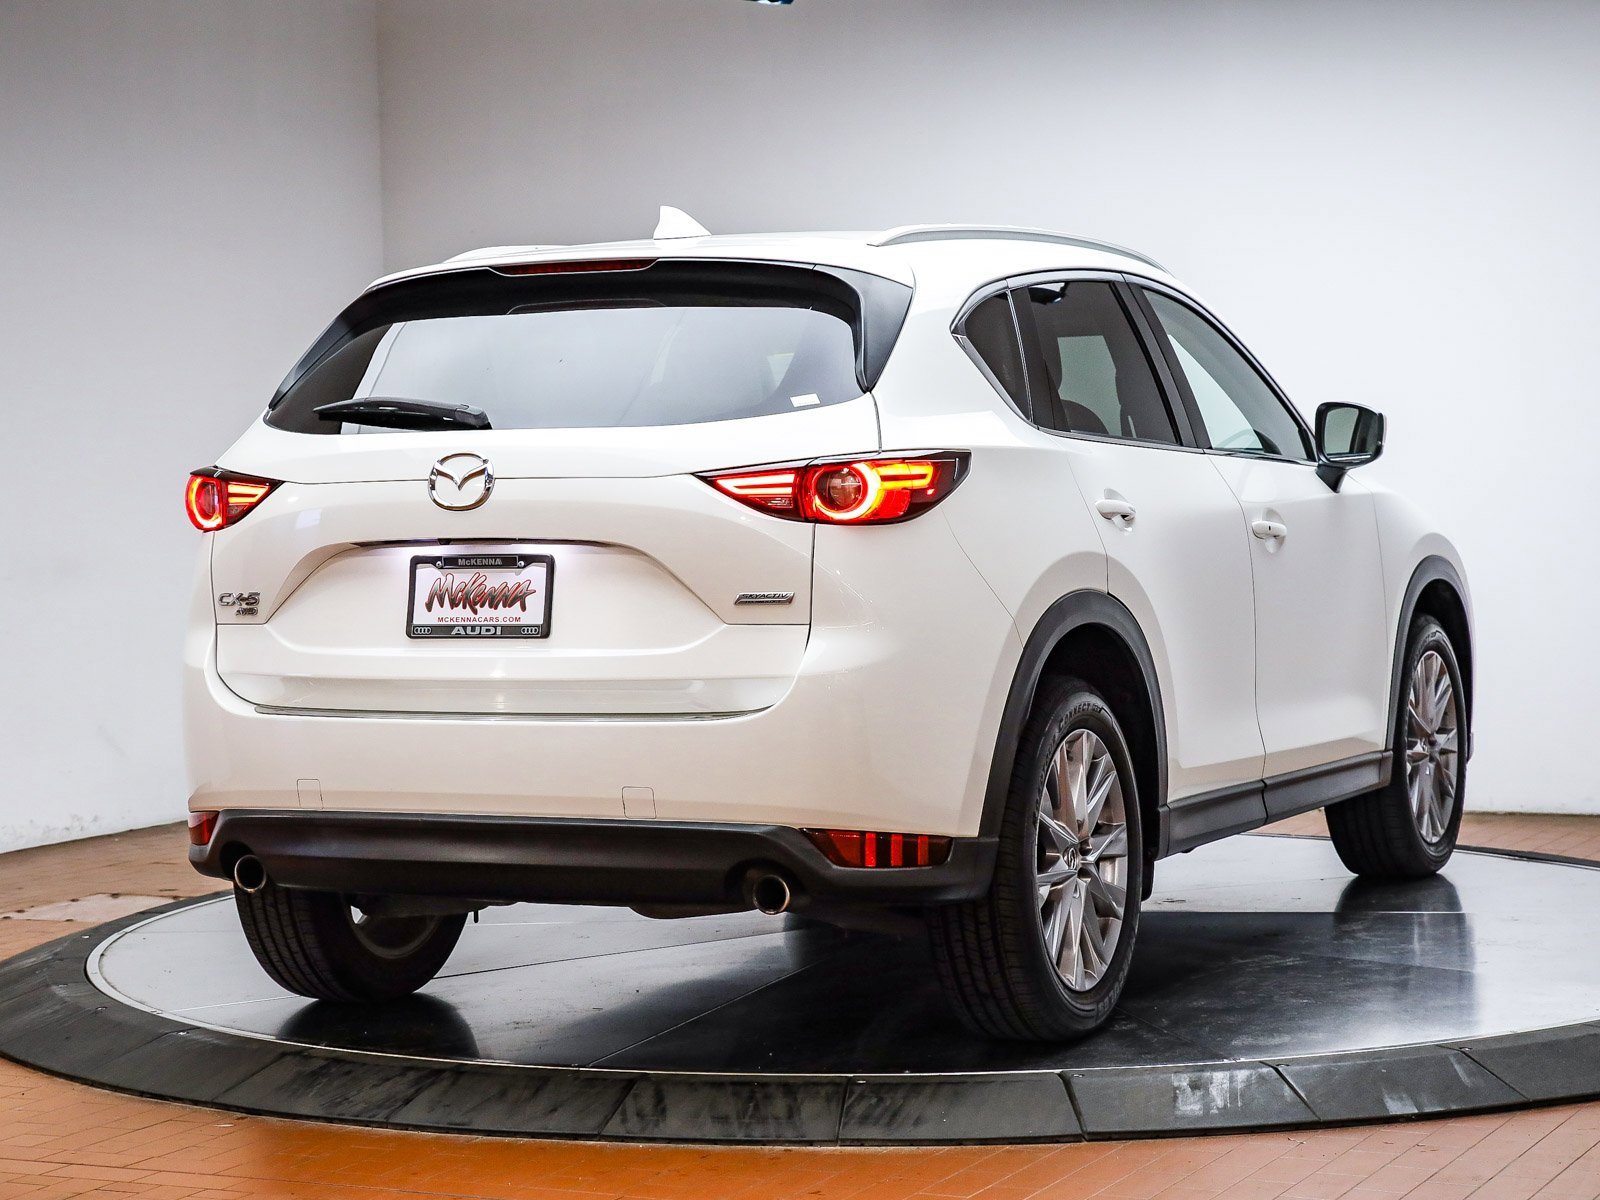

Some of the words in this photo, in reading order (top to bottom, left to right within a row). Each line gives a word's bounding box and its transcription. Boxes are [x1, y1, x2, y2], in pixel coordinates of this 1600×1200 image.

[458, 558, 502, 566] McKENNA
[218, 592, 260, 606] CX-5
[451, 626, 502, 635] AUDI
